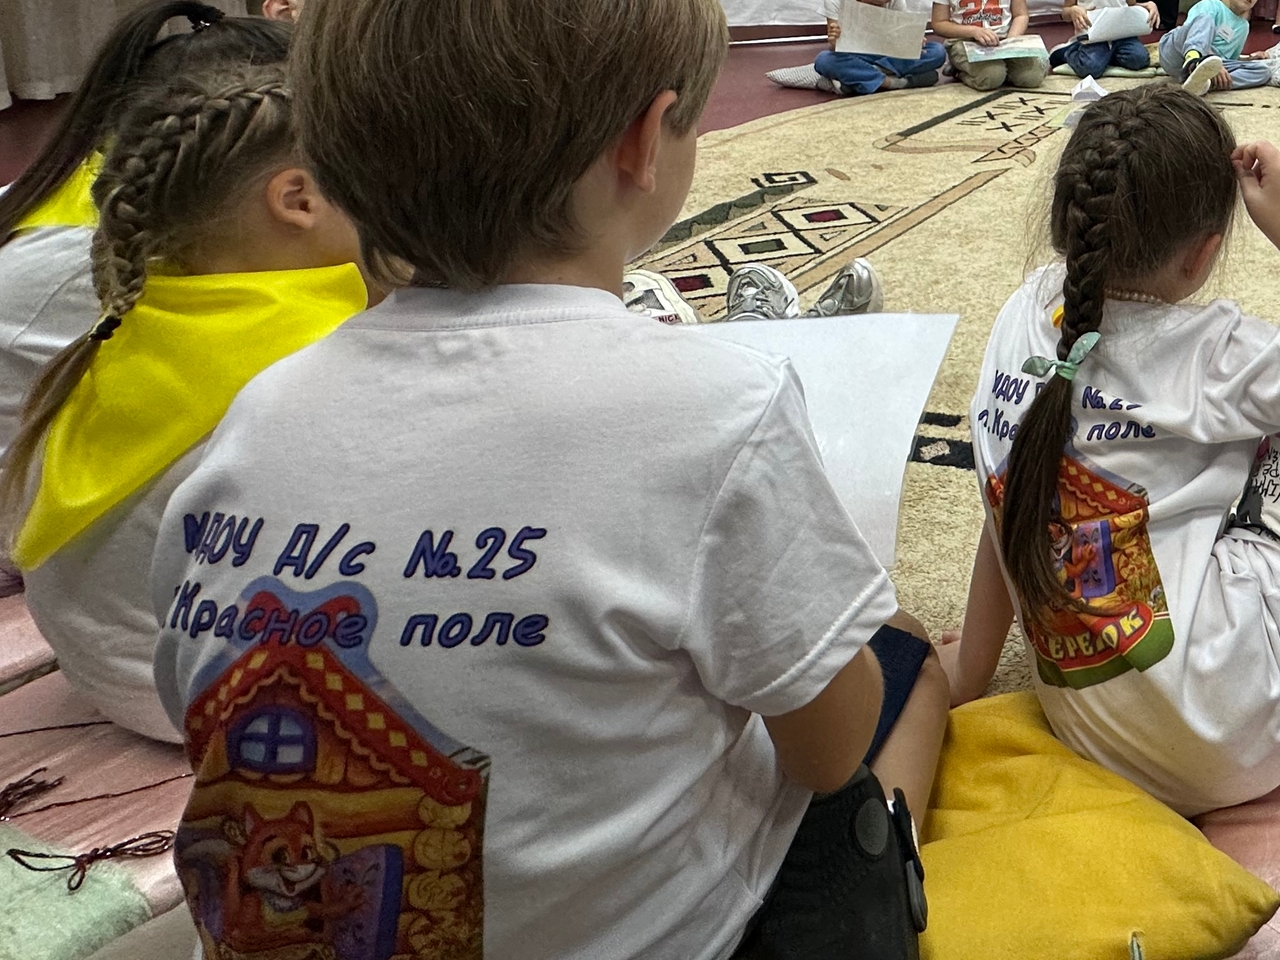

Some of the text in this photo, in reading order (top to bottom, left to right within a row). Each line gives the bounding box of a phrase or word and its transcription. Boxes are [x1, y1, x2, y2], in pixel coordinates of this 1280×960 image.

[1087, 421, 1156, 441] поле
[273, 523, 376, 580] Д/с
[400, 612, 549, 648] поле
[1045, 606, 1144, 660] ЕРЕОК
